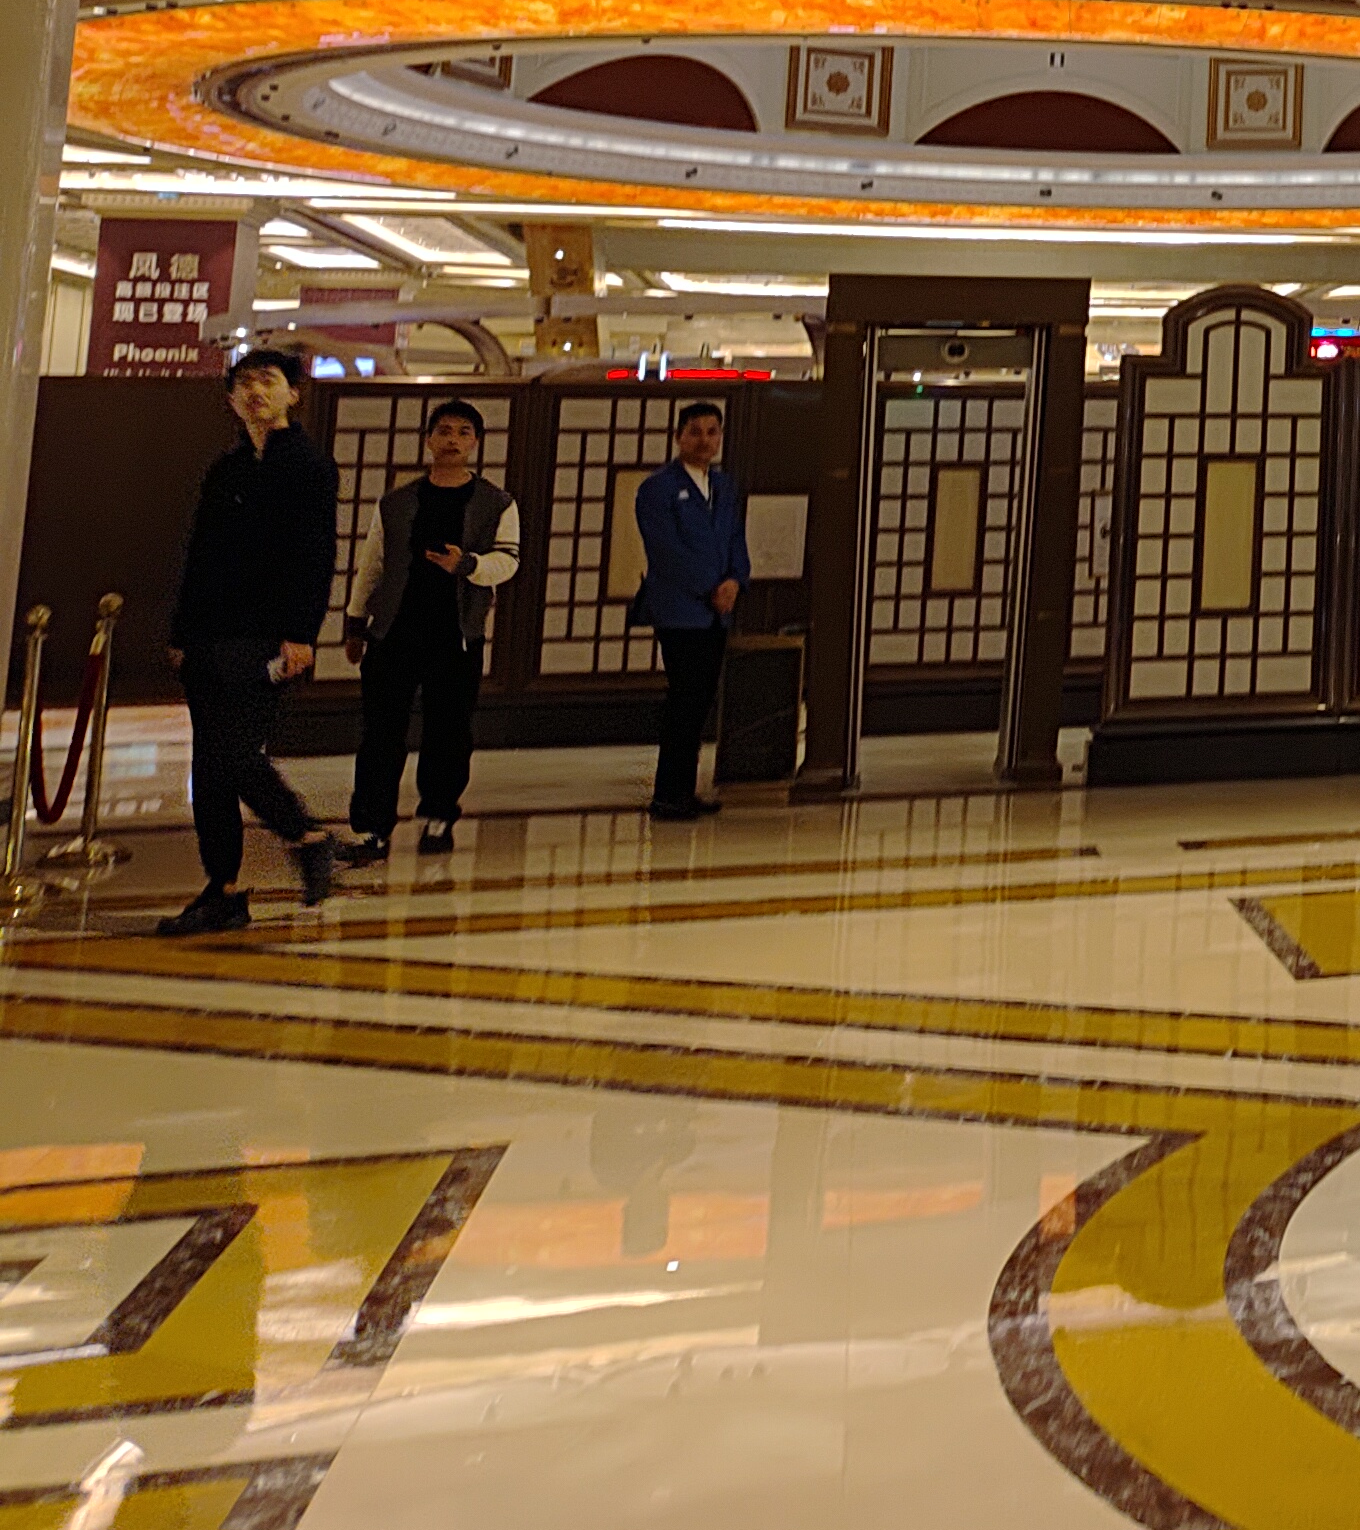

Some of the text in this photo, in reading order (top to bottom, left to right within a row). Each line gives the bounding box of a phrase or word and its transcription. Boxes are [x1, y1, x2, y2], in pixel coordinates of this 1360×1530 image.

[112, 301, 208, 323] 现已登场
[112, 342, 199, 363] Phoenix
